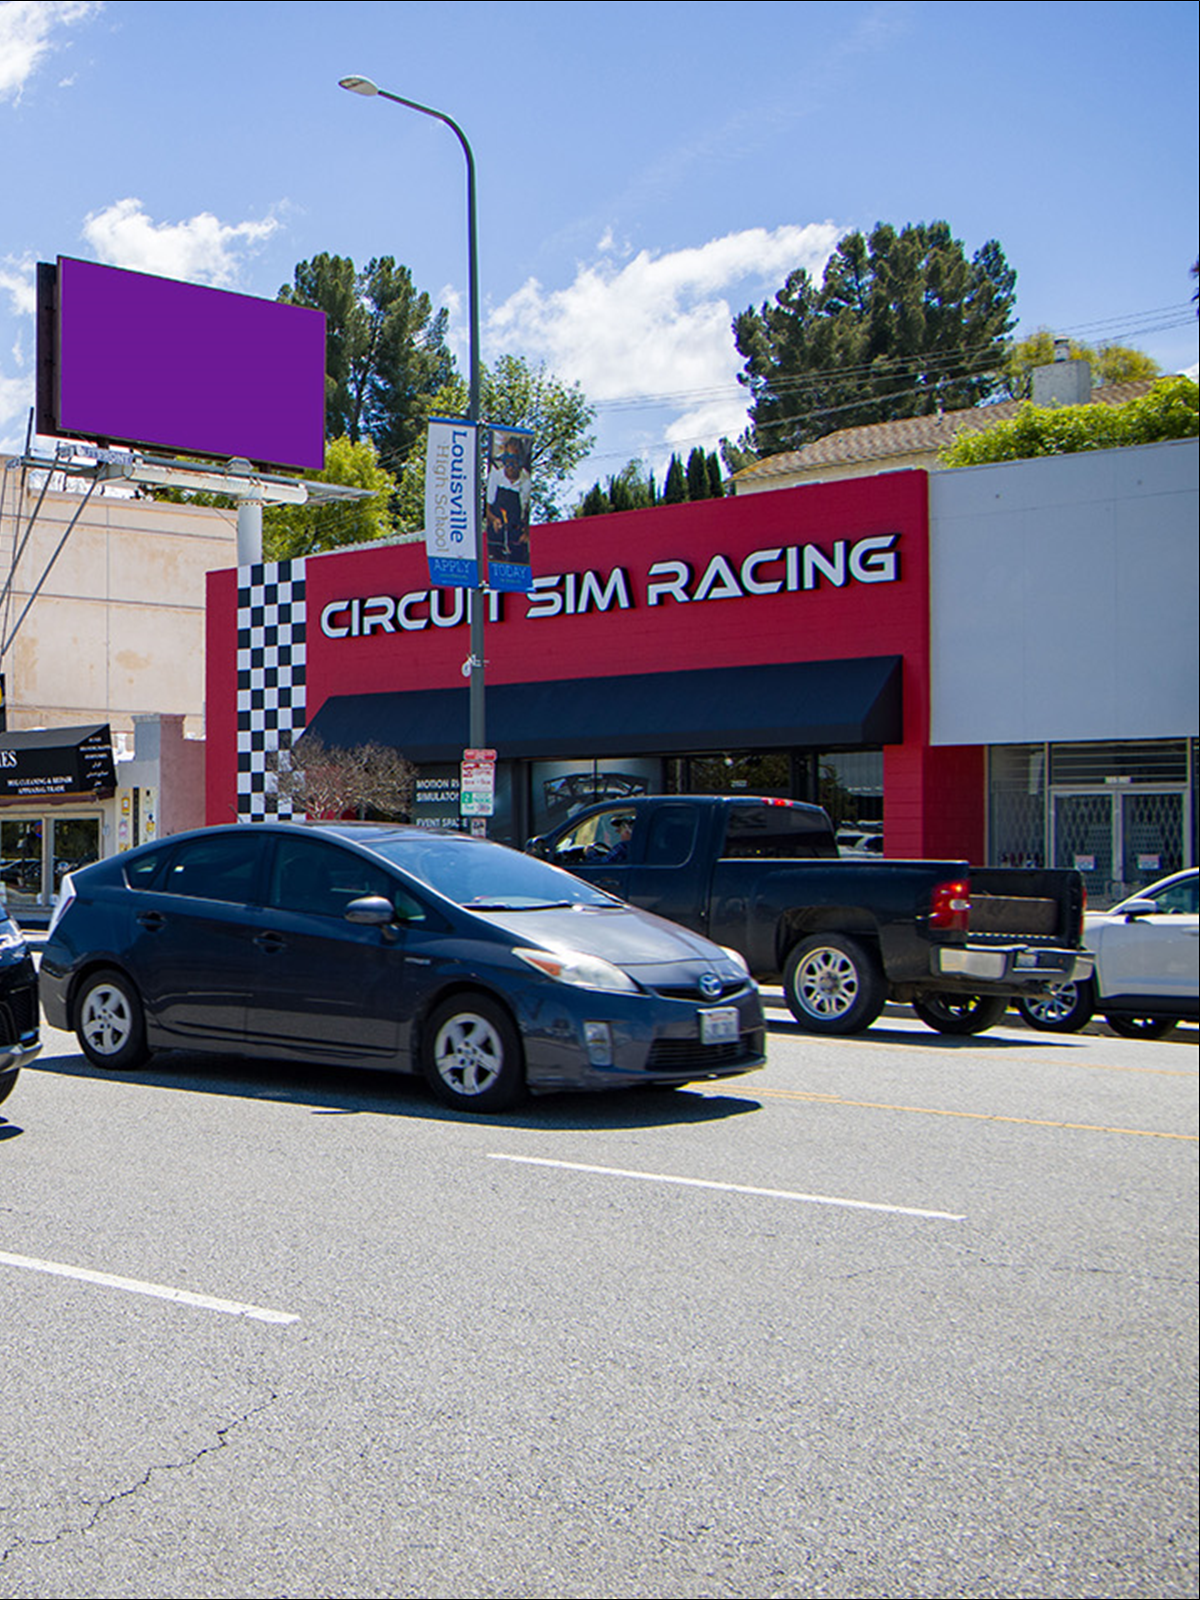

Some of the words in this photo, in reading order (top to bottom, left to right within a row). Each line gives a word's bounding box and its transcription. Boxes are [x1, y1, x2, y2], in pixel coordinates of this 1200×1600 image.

[433, 445, 449, 488] High
[450, 430, 467, 544] Louisville
[434, 494, 449, 552] School
[434, 559, 471, 574] APPLY
[491, 563, 527, 579] TODAY
[320, 587, 500, 638] CIRCUIT
[525, 567, 632, 618] SIM
[647, 534, 899, 606] RACING
[416, 779, 449, 789] MOTION
[416, 818, 440, 827] EVENT
